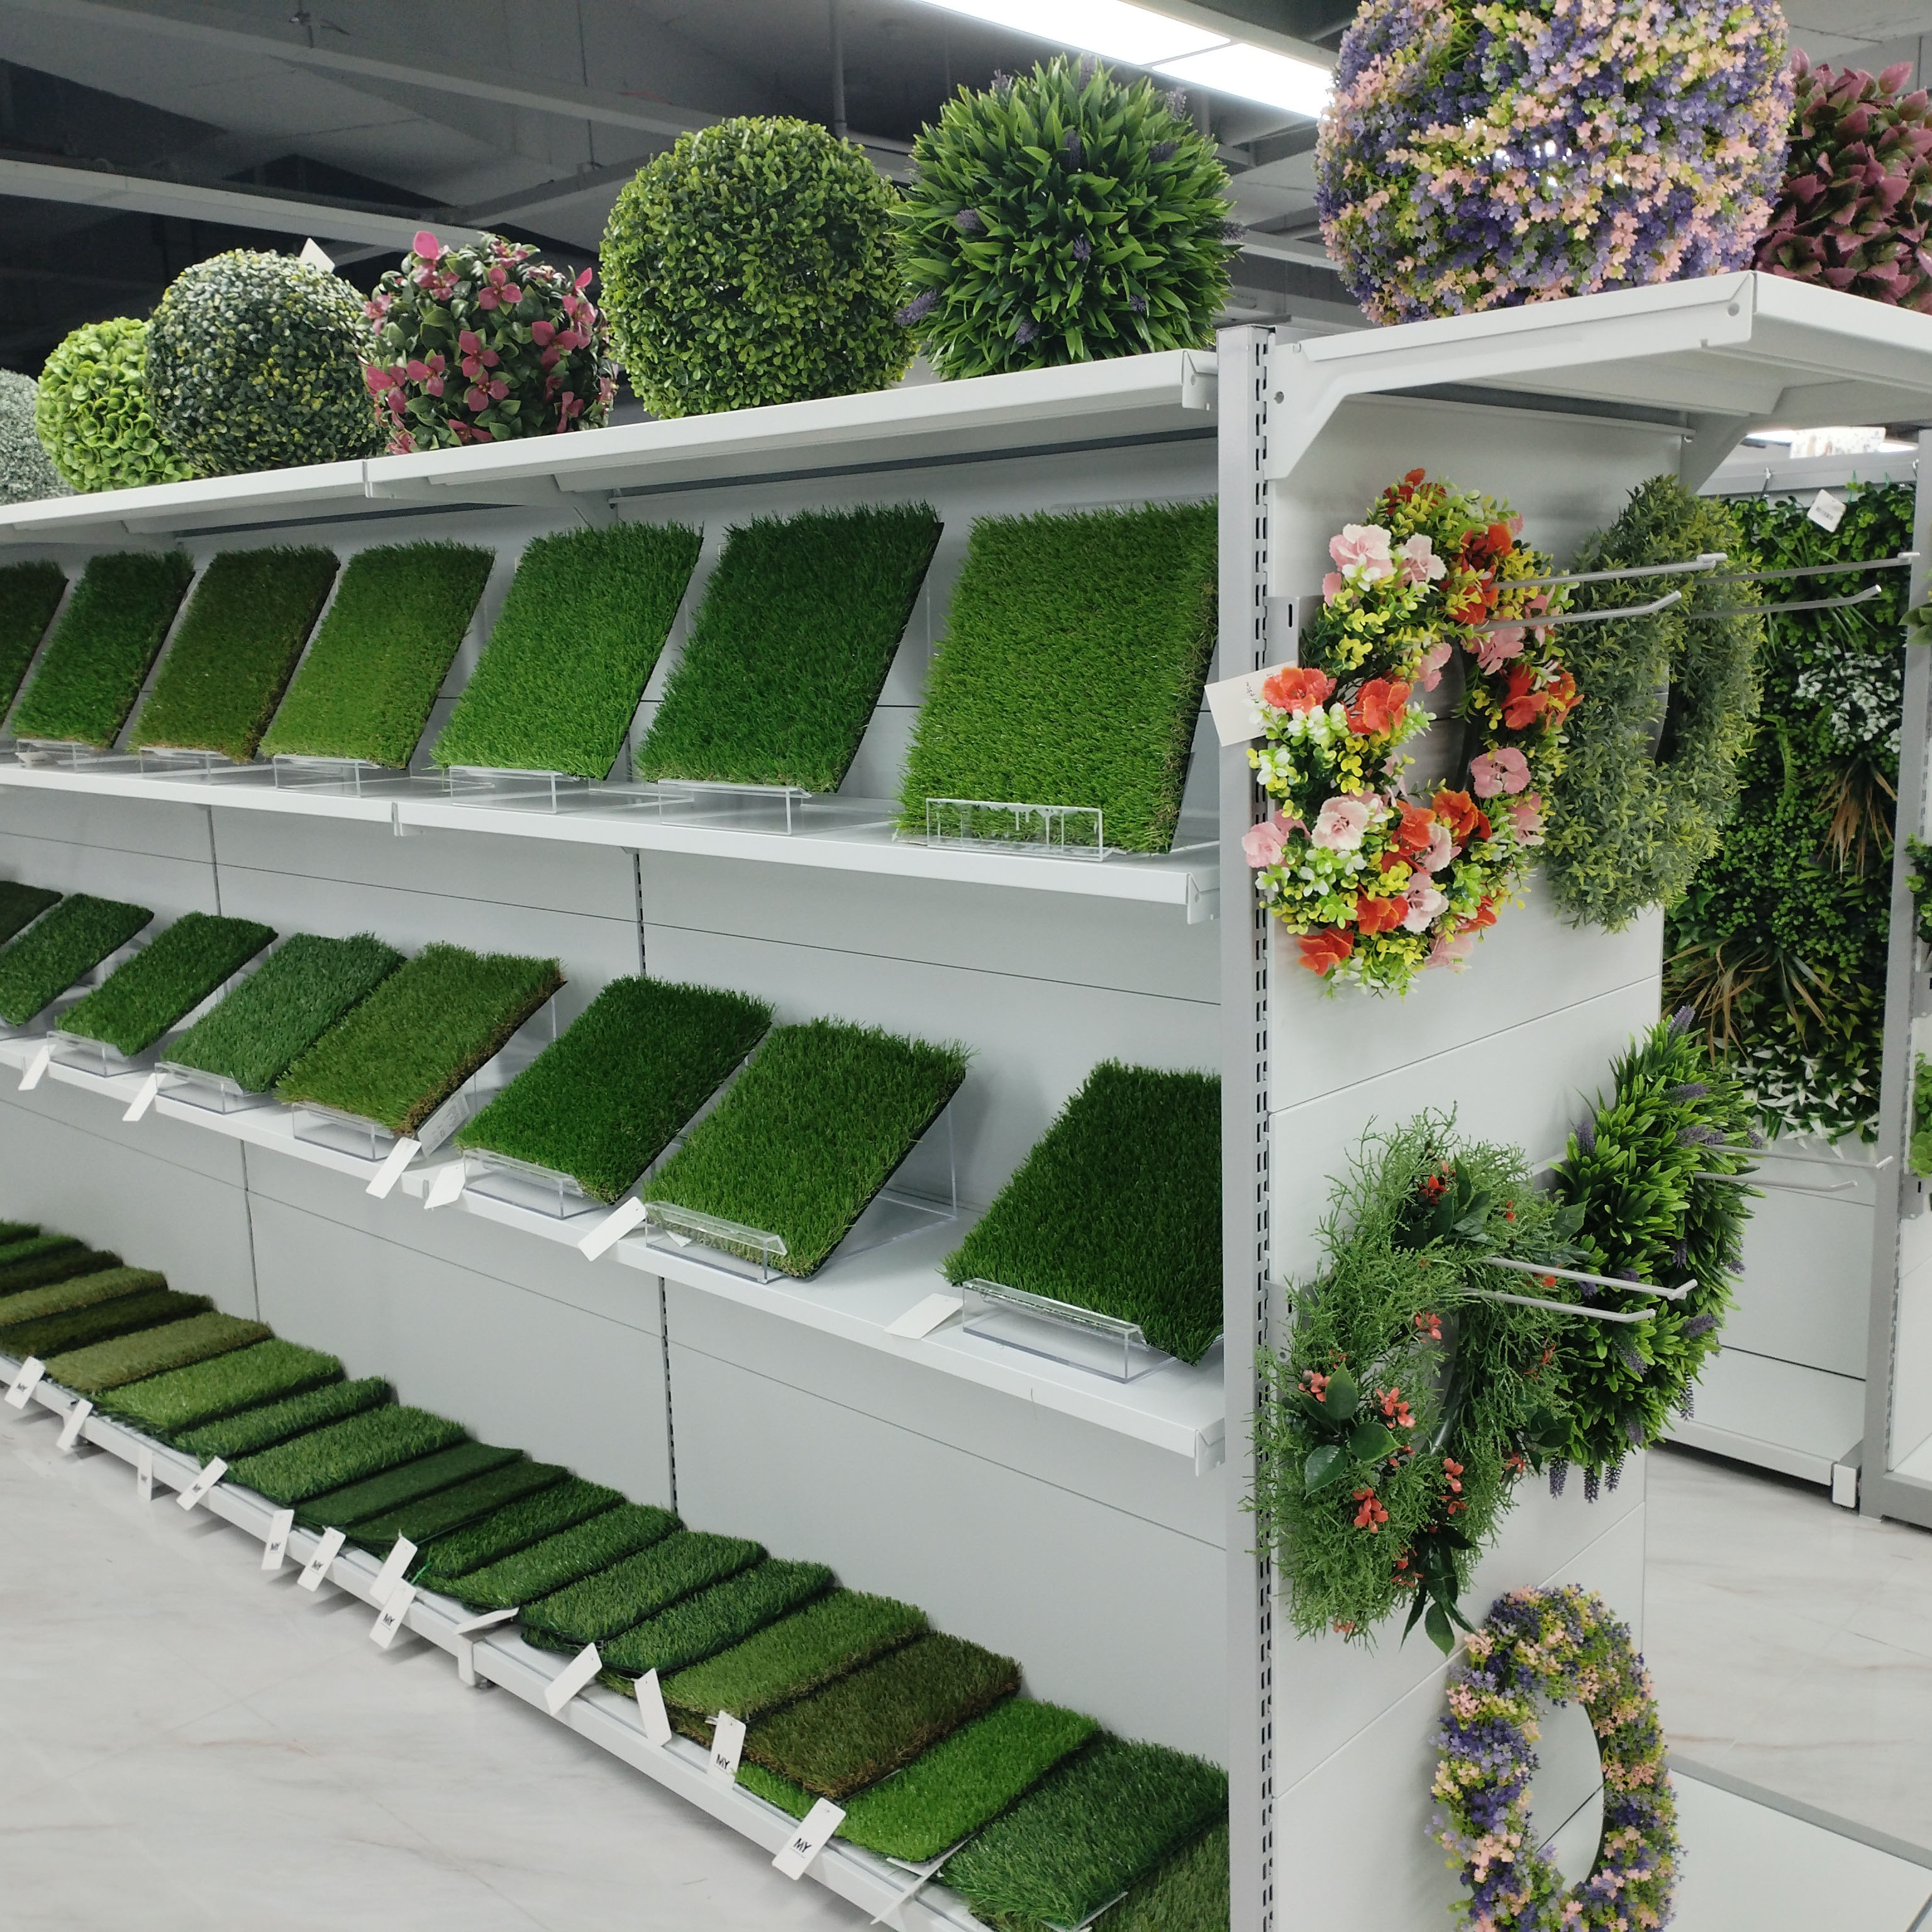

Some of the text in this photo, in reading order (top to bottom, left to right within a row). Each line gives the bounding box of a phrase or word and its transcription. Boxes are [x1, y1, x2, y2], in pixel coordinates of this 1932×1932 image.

[270, 1543, 281, 1551] MY
[311, 1560, 323, 1571] MY
[383, 1613, 396, 1626] MY
[716, 1753, 730, 1768] MY
[793, 1838, 812, 1853] MY
